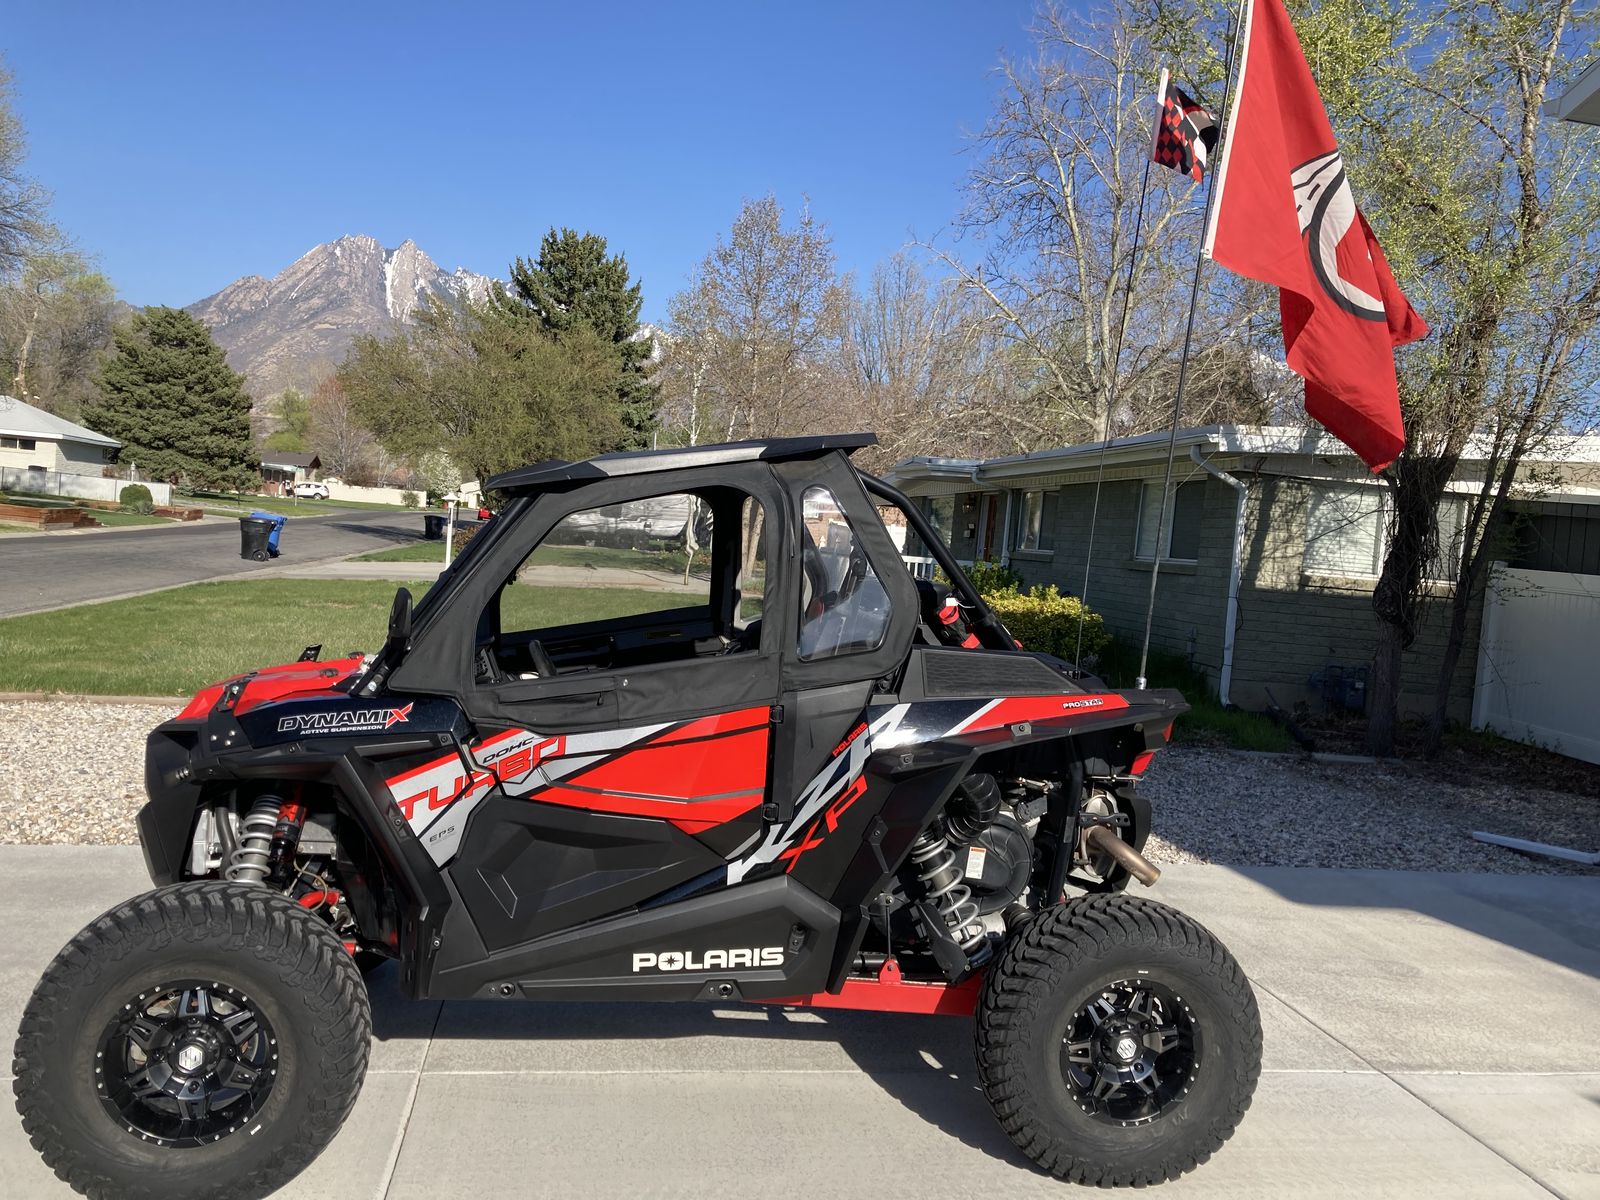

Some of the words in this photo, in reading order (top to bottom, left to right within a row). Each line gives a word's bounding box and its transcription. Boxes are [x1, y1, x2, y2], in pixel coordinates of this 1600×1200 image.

[277, 702, 414, 732] DYNAMIX
[1062, 698, 1103, 709] PROSTAR
[330, 725, 383, 733] SUSPENSION
[832, 722, 868, 757] POLARIS
[483, 736, 534, 764] DOHC
[398, 735, 567, 821] TURBO
[430, 824, 455, 842] EPS
[778, 774, 868, 874] XP
[632, 946, 785, 972] POLARIS
